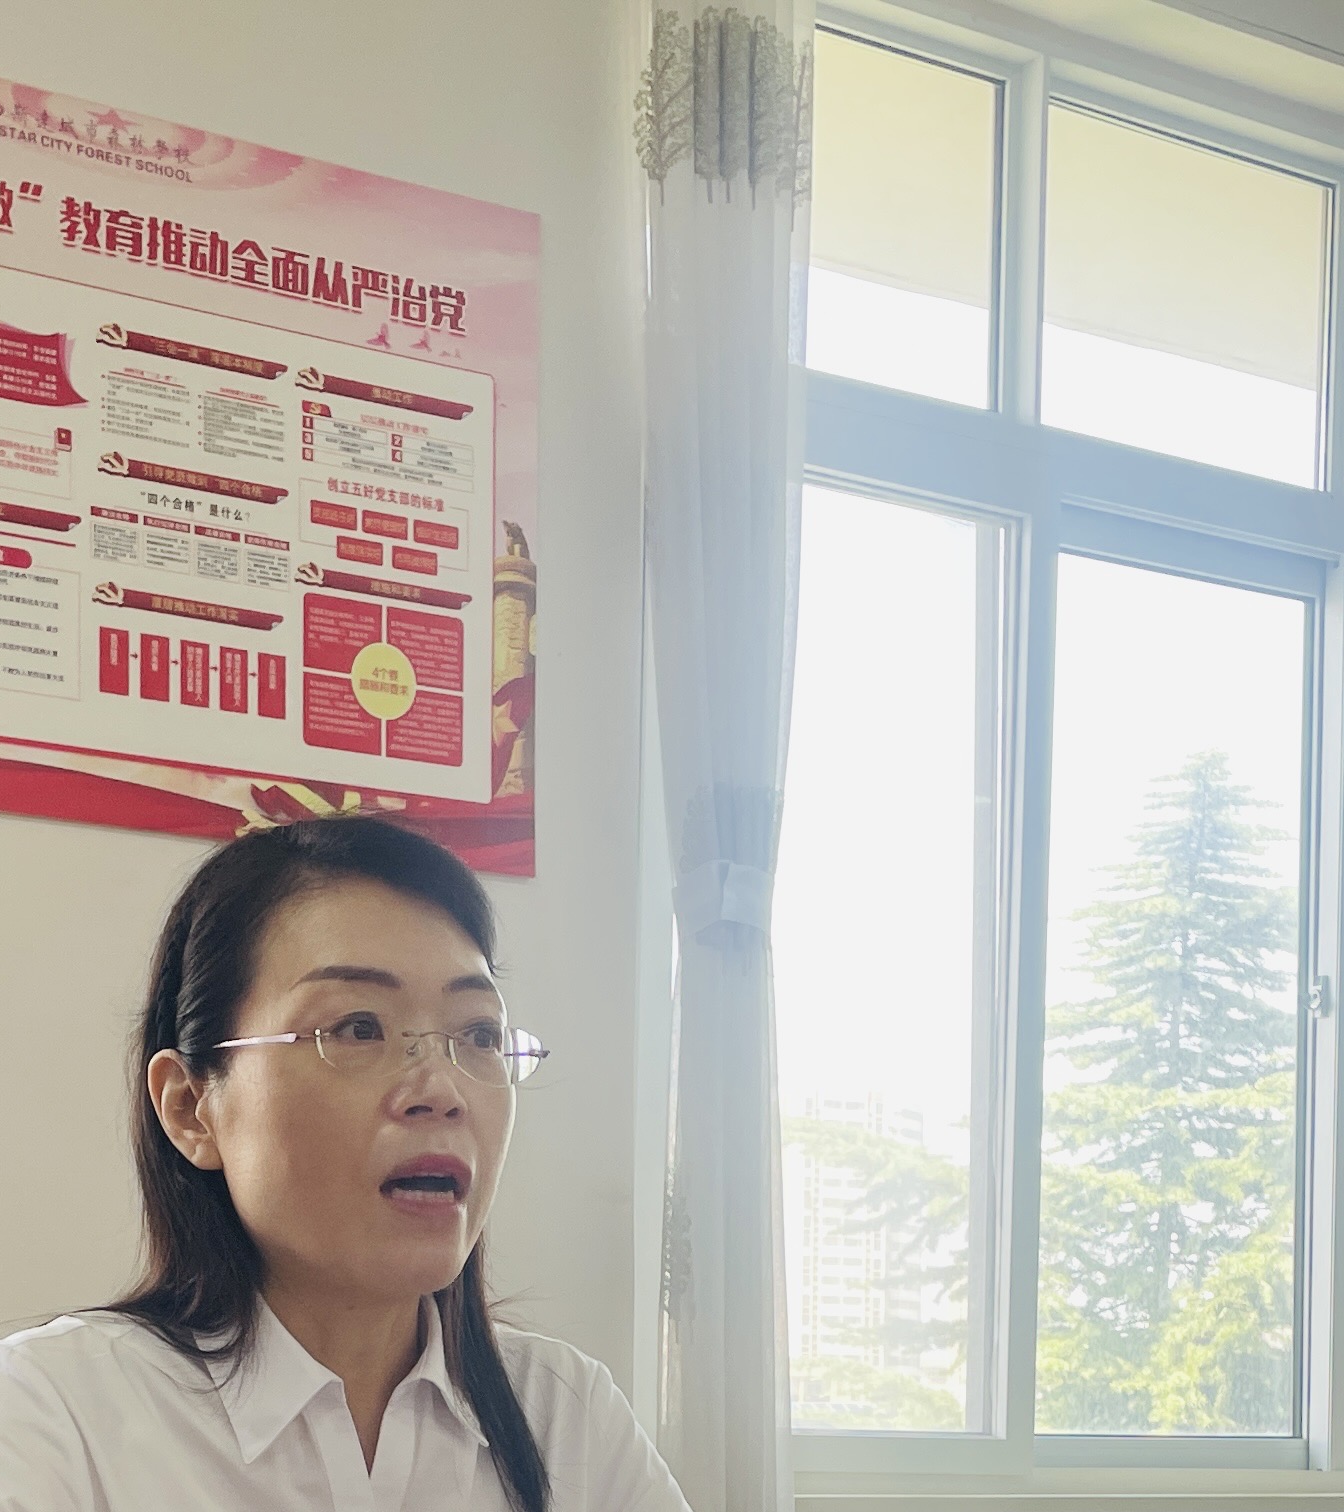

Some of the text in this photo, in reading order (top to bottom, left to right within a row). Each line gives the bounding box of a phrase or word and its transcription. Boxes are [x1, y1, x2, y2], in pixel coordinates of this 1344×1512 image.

[41, 135, 72, 152] CITY
[76, 144, 132, 168] FOREST
[136, 159, 193, 183] SCHOOL
